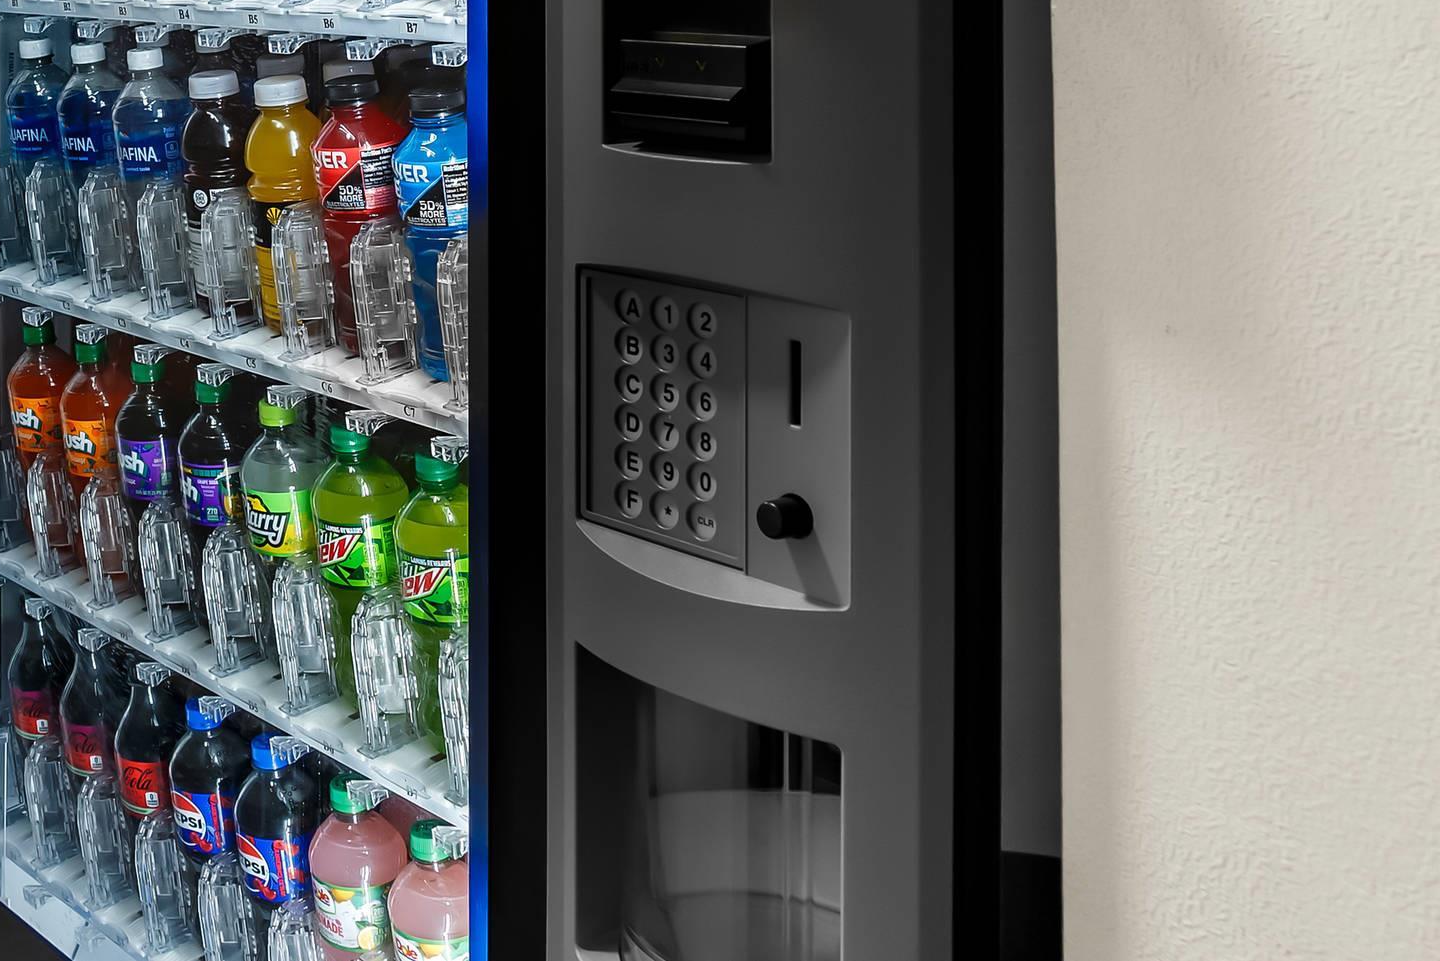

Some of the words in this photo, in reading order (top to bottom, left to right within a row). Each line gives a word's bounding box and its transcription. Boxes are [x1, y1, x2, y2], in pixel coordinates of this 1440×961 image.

[63, 2, 72, 11] B2
[118, 6, 127, 15] B3
[178, 9, 190, 19] B4
[248, 15, 258, 24] B5
[323, 18, 335, 29] B6
[406, 22, 418, 33] B7
[10, 128, 49, 144] UAFINA
[338, 184, 363, 196] 50%
[339, 195, 365, 203] MORE
[419, 200, 445, 211] 50%
[420, 210, 445, 219] MORE
[626, 297, 640, 318] A
[664, 304, 672, 324] 1
[700, 311, 711, 332] 2
[627, 336, 639, 356] B
[663, 343, 674, 364] 3
[700, 351, 711, 372] 4
[246, 357, 257, 369] C5
[321, 381, 333, 394] C6
[403, 405, 415, 418] C7
[626, 374, 640, 394] C
[663, 383, 674, 403] 5
[700, 391, 711, 412] 6
[12, 408, 40, 430] ush
[65, 431, 93, 455] ush
[627, 412, 639, 433] D
[663, 422, 674, 442] 7
[700, 431, 711, 453] 8
[627, 451, 639, 472] E
[663, 461, 674, 482] 9
[700, 471, 711, 492] 0
[206, 507, 218, 515] 270
[626, 489, 639, 509] F
[697, 516, 714, 528] CLR
[247, 503, 287, 546] arry
[122, 766, 153, 790] Cola
[176, 812, 203, 829] EPSI
